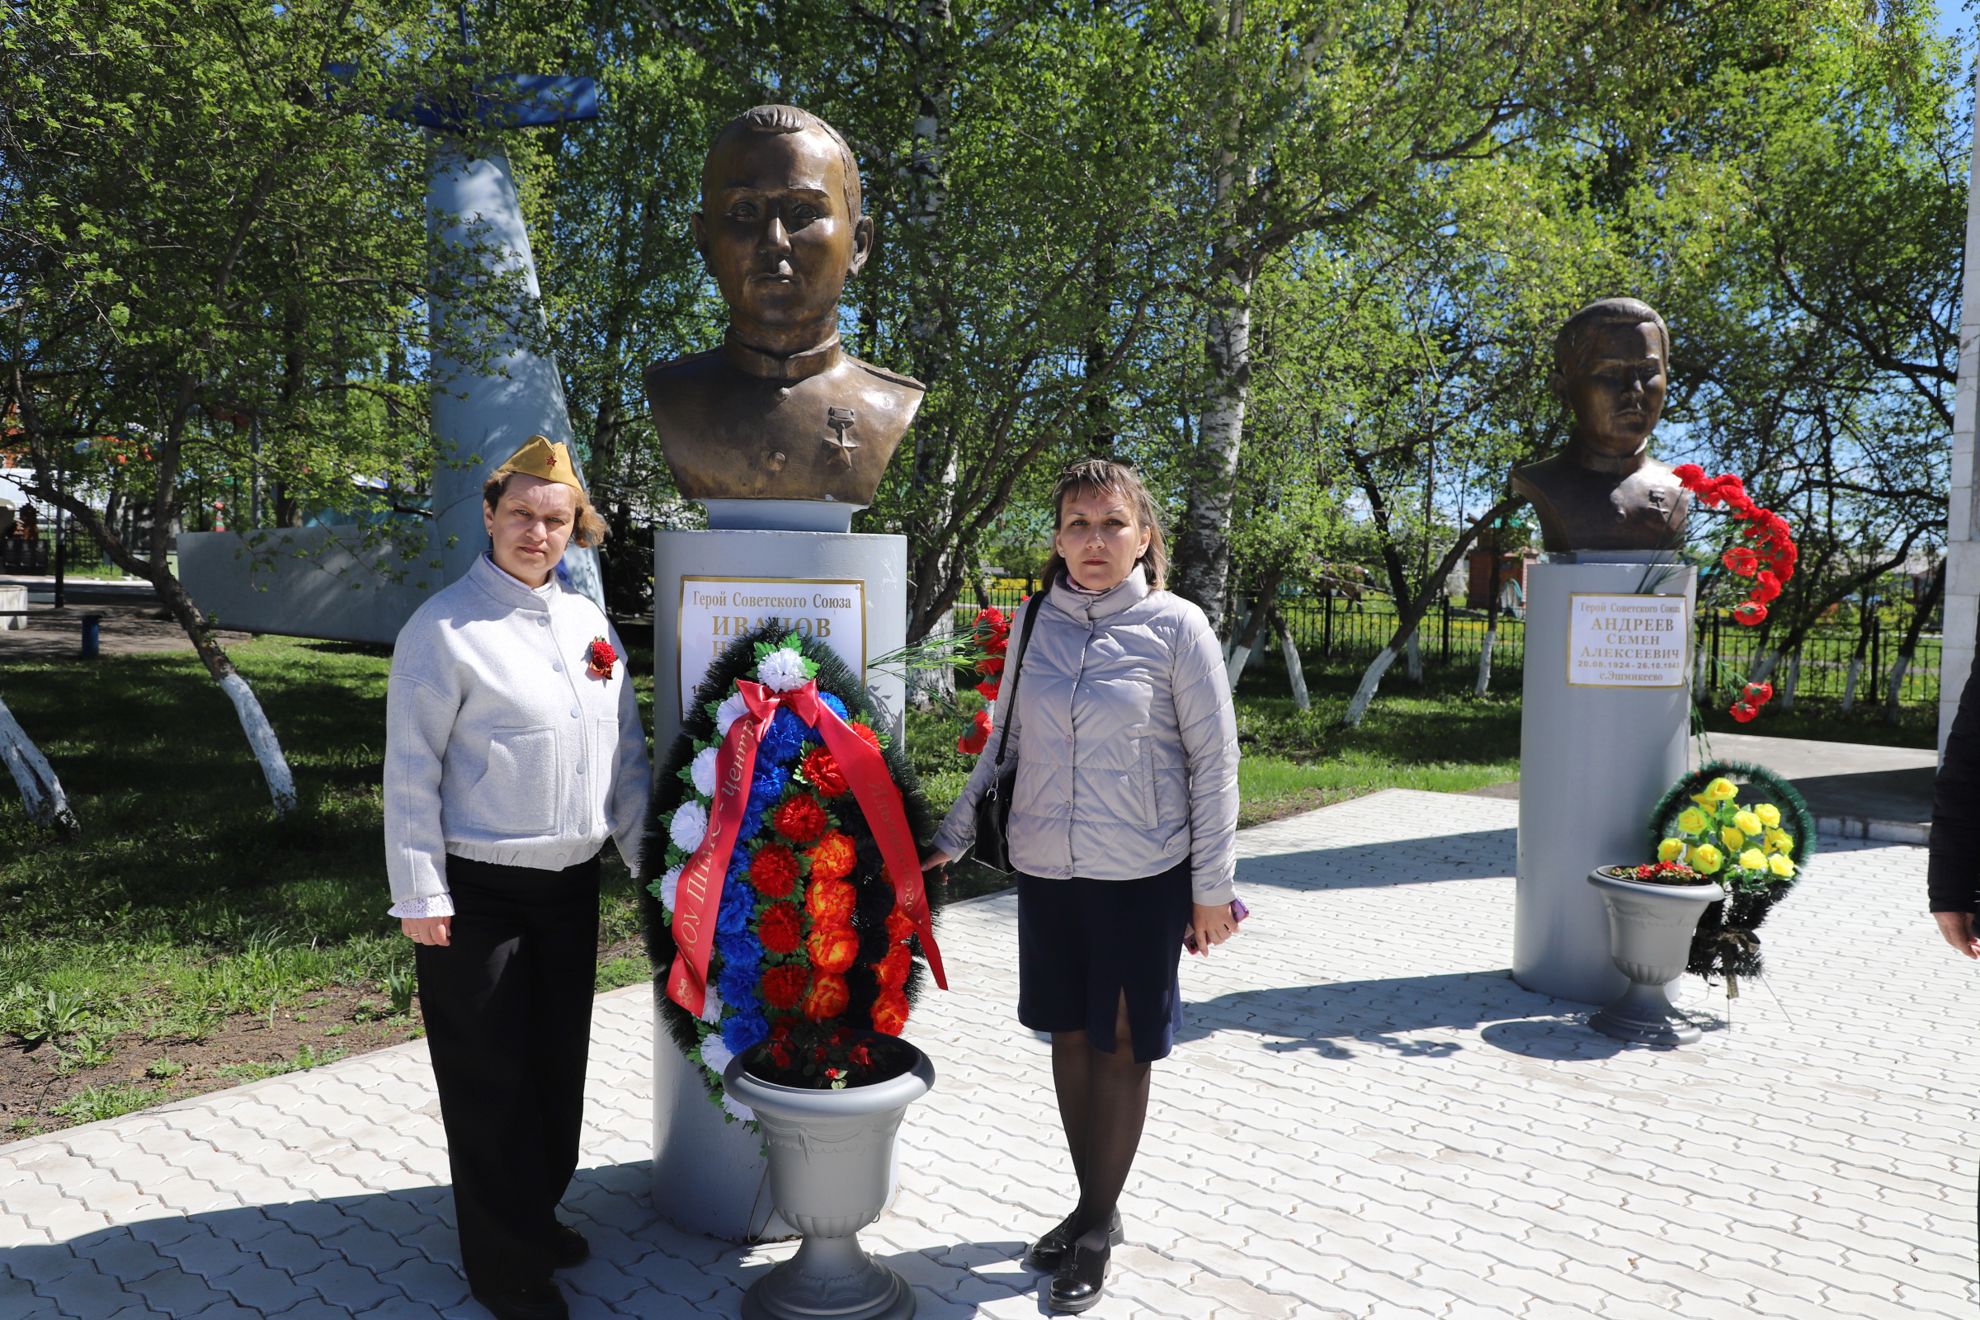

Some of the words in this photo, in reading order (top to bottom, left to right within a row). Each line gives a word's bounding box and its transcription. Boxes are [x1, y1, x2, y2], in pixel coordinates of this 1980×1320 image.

[693, 591, 727, 609] Герой
[733, 592, 807, 608] Советского
[813, 593, 851, 609] Союза
[1580, 602, 1606, 615] Герой
[1610, 603, 1658, 613] Советского
[1591, 617, 1674, 632] АНДРЕЕВ
